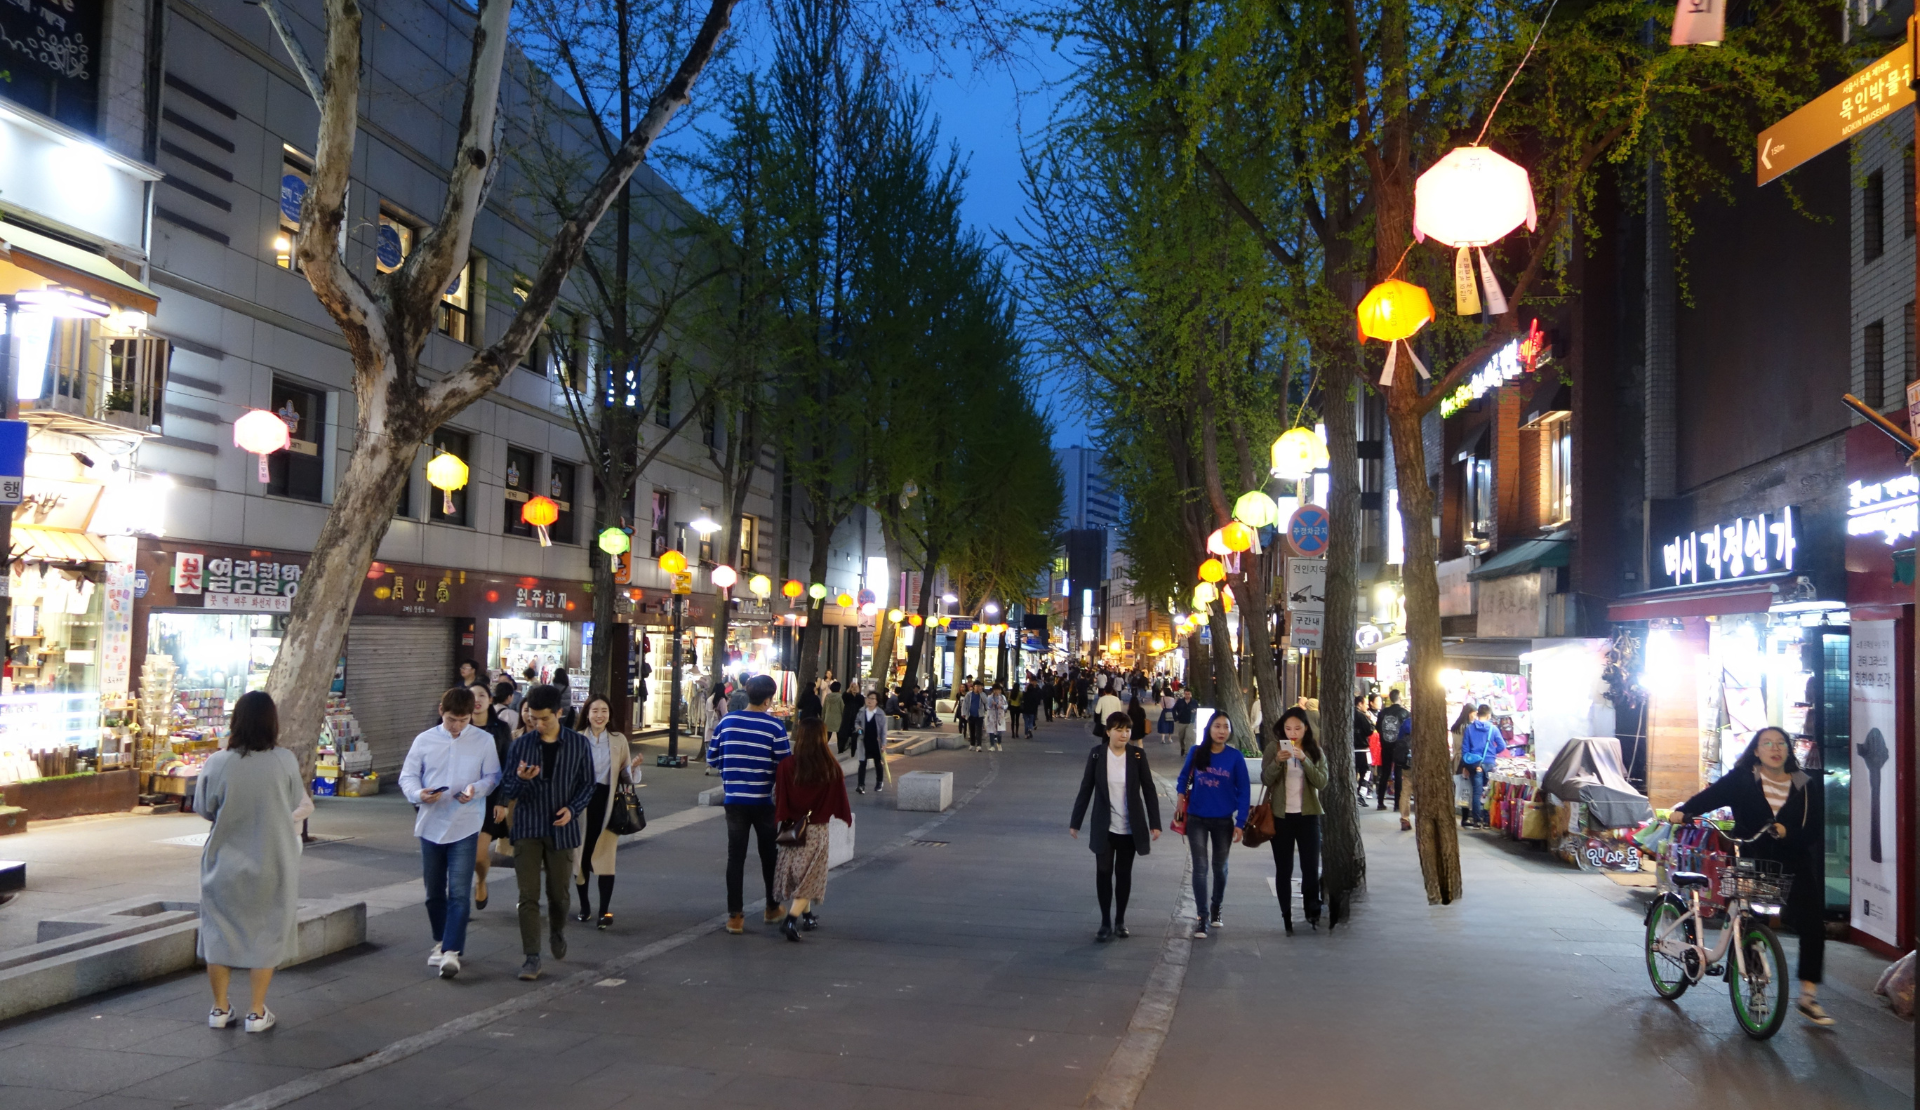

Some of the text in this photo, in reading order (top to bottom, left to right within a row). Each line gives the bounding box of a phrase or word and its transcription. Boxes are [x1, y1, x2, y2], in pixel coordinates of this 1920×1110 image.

[1842, 102, 1890, 136] MOKIN MUSEUM
[4, 481, 20, 499] 행
[1293, 526, 1328, 535] 주정차금지
[179, 557, 202, 589] 붓
[208, 557, 303, 598] 열림필방
[1293, 564, 1326, 574] 견인지역
[210, 594, 218, 607] 붓
[251, 597, 272, 609] 화선지
[275, 598, 288, 610] 한지
[515, 587, 567, 609] 원주한지
[1295, 616, 1320, 626] 구간내
[1297, 637, 1317, 646] 100m
[1877, 672, 1891, 689] 조각
[1587, 847, 1639, 872] 인사동
